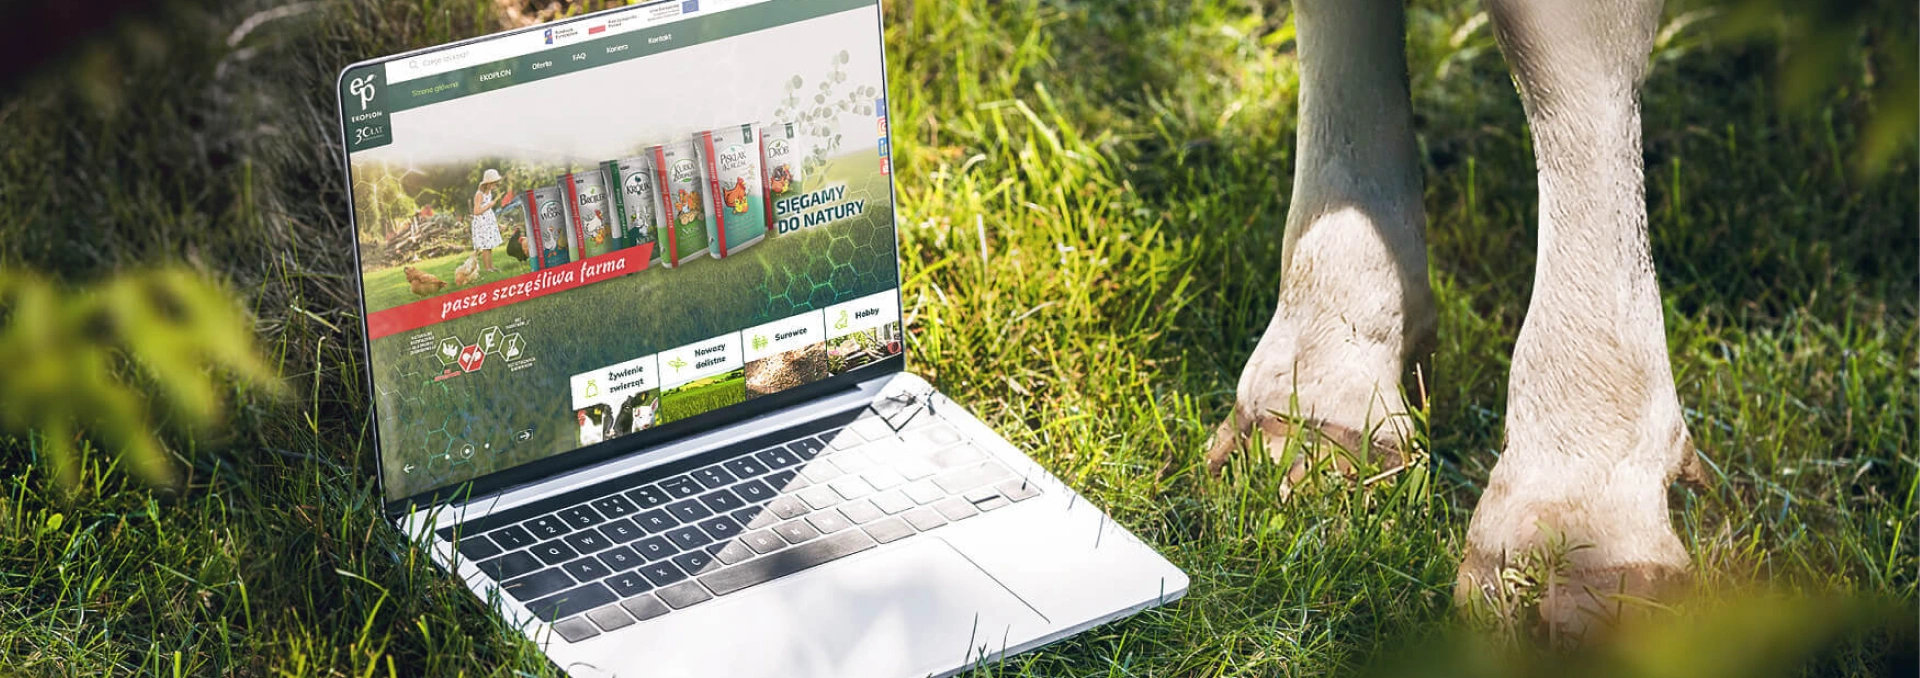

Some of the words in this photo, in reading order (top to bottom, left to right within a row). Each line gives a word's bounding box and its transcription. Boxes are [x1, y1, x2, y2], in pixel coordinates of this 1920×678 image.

[647, 33, 673, 44] Kontakt
[606, 44, 629, 54] Kariera
[532, 60, 553, 70] Oferta
[572, 53, 587, 62] FAQ
[479, 69, 511, 82] EKOPLON
[351, 111, 382, 123] EKOPLON
[776, 185, 846, 215] SIĘGAMY
[778, 217, 800, 235] DO
[804, 199, 865, 228] NATURY
[441, 292, 487, 318] pasze
[492, 270, 574, 301] szczęśliwa
[580, 256, 627, 283] farma
[854, 306, 880, 320] Hobby
[774, 326, 808, 342] Surowce
[694, 342, 726, 358] Nawozy
[695, 355, 726, 370] dolistne
[608, 365, 644, 381] Żywienie
[609, 378, 644, 393] zwierząt
